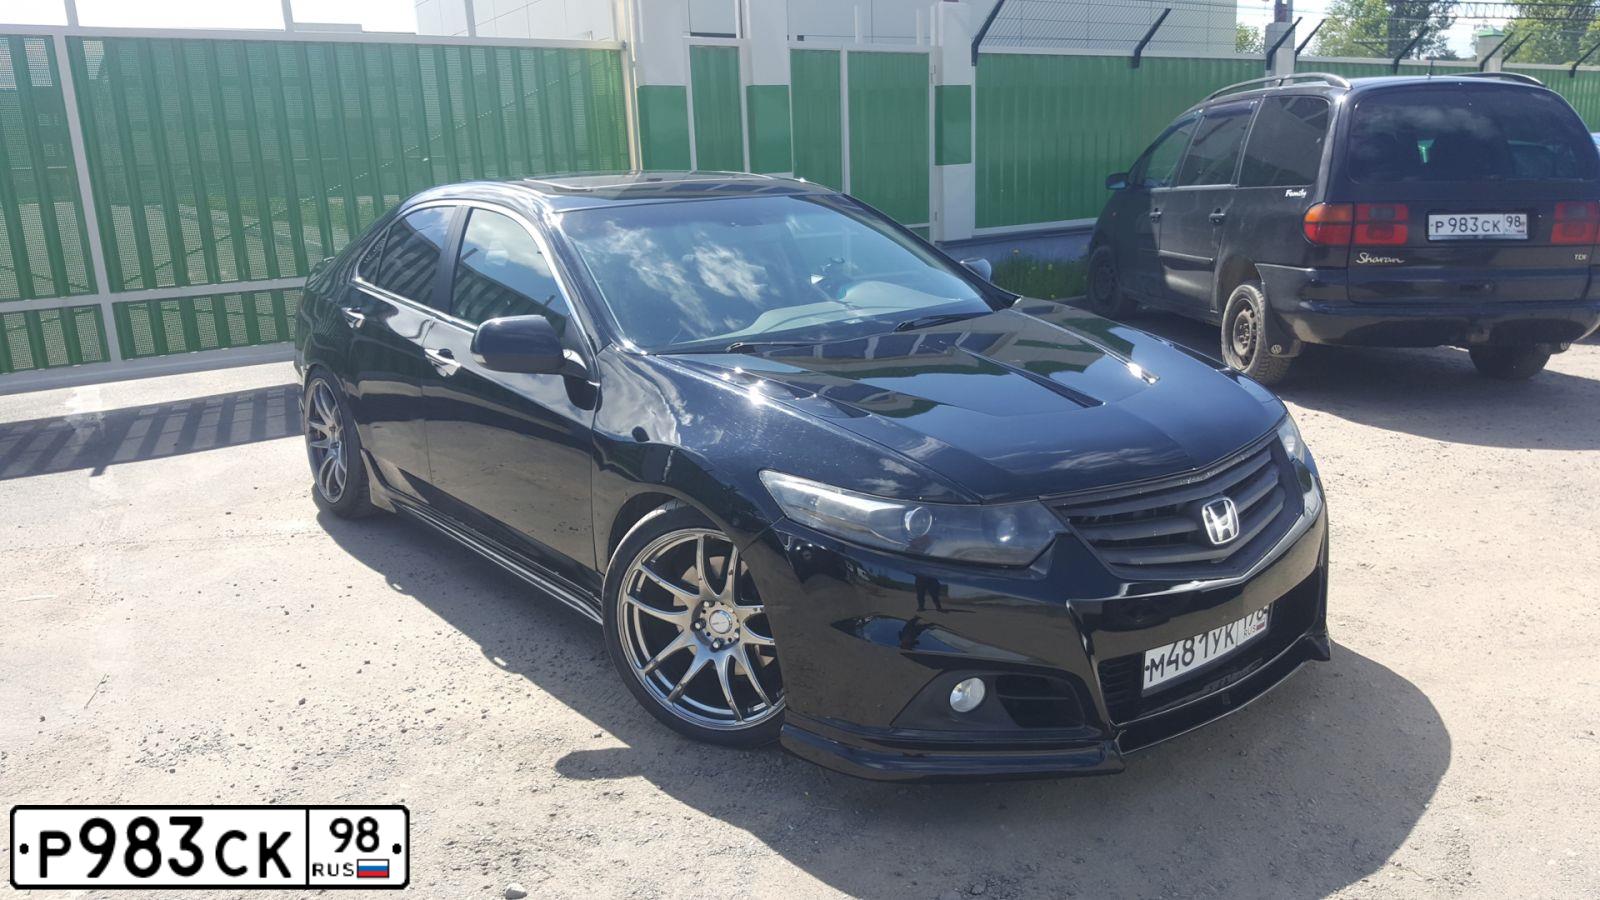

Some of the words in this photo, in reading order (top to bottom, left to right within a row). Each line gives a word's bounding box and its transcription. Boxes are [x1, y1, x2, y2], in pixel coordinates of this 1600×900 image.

[1285, 189, 1307, 198] Family
[1435, 217, 1501, 233] Р983СК
[1506, 215, 1521, 228] 98
[1356, 252, 1405, 264] Sharan
